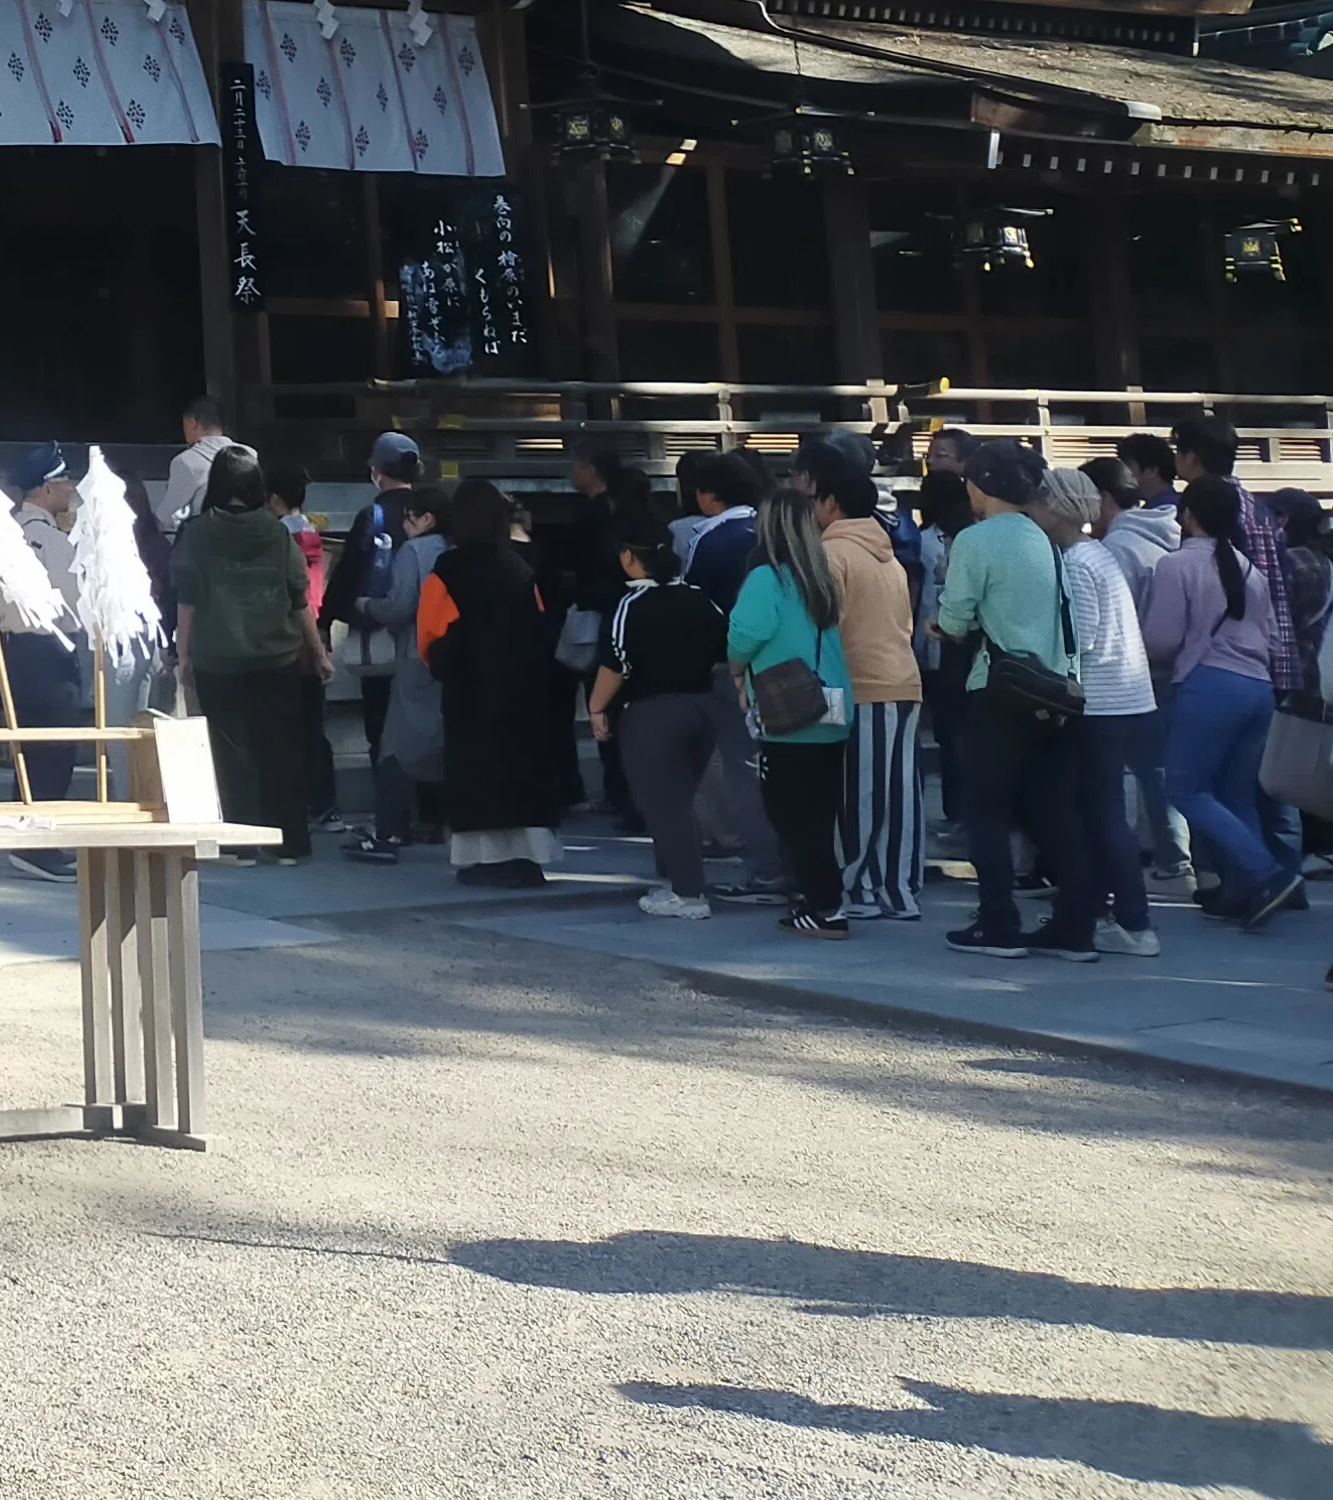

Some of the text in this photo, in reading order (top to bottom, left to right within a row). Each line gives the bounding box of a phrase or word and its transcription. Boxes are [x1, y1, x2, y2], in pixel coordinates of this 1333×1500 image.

[229, 79, 247, 150] 二月二十三日
[233, 209, 261, 306] 天長祭
